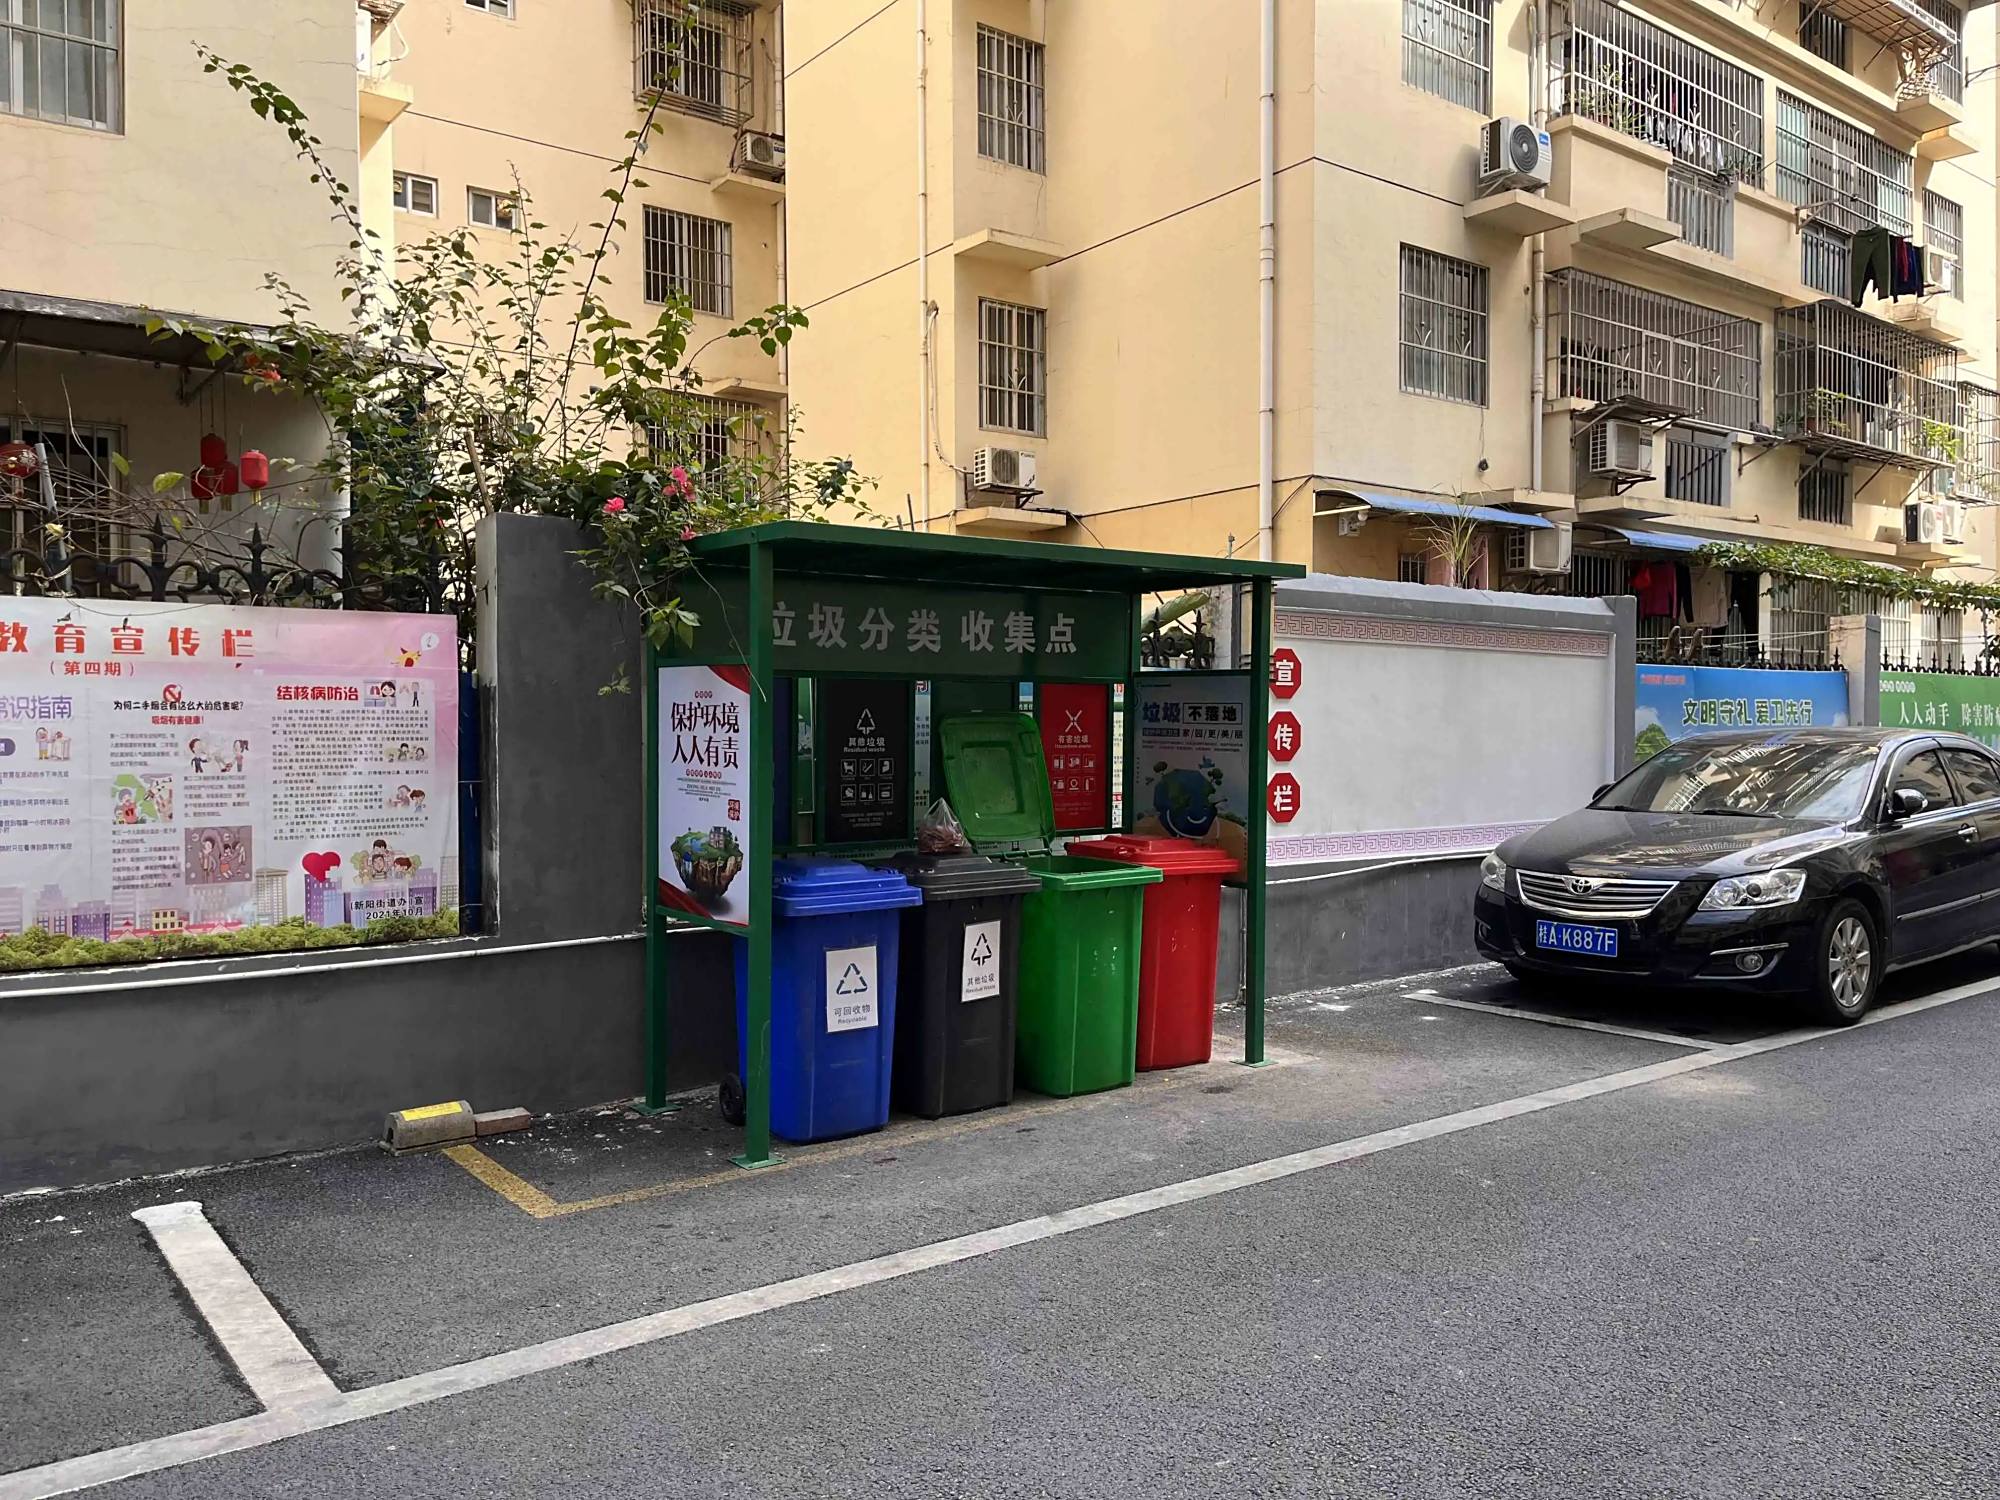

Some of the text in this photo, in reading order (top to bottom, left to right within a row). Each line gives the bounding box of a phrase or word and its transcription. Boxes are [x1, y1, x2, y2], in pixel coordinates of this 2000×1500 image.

[277, 685, 359, 701] 结核病防治
[671, 702, 739, 733] 保护环境
[1899, 701, 1950, 726] 人人动手
[671, 735, 739, 769] 人人有责
[366, 907, 424, 920] 2021年10月
[833, 1004, 871, 1018] 可回收物
